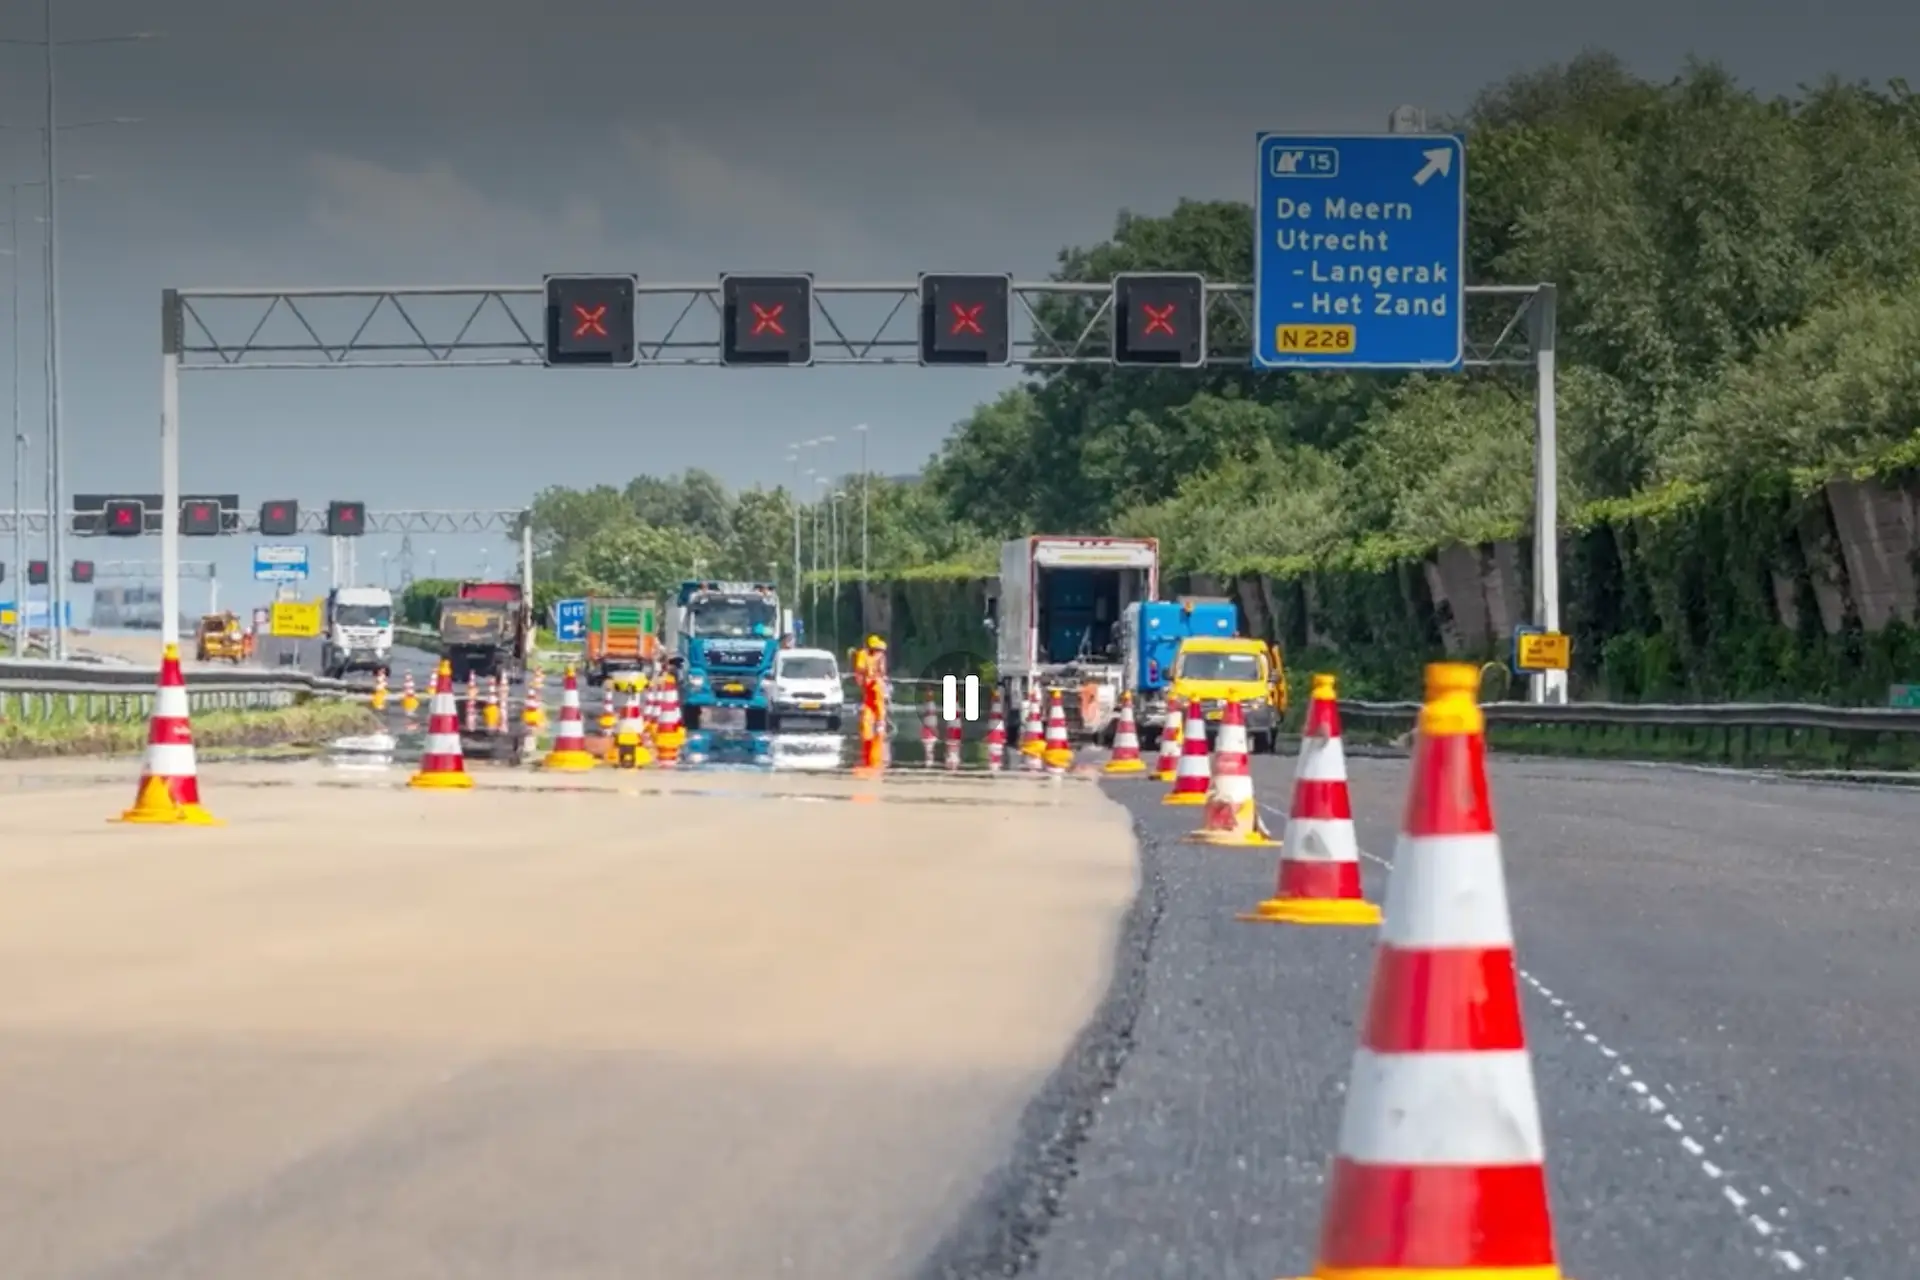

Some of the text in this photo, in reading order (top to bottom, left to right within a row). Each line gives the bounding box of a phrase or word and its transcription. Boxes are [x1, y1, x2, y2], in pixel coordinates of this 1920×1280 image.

[1309, 154, 1331, 170] 15
[1277, 197, 1412, 220] De Meern
[1277, 229, 1388, 251] Utrecht
[1374, 293, 1446, 316] Zand
